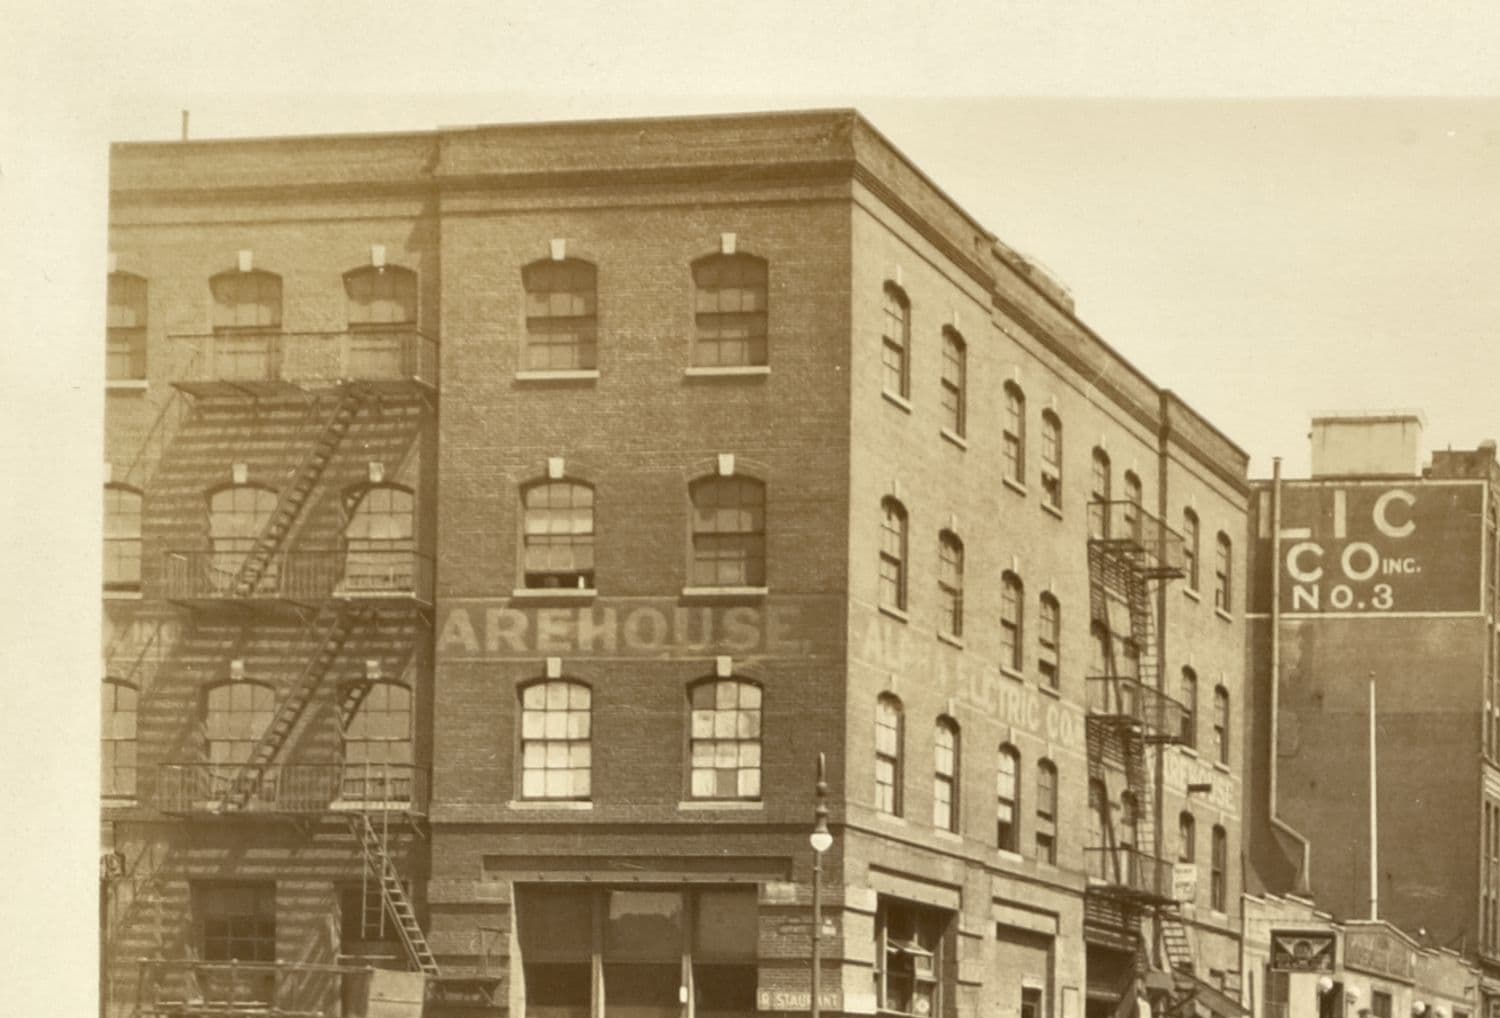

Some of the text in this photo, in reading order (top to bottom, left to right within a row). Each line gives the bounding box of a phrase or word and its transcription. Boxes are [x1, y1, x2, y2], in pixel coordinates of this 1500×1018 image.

[1286, 542, 1421, 581] CO INC.
[761, 992, 837, 1007] RSTAUNT
